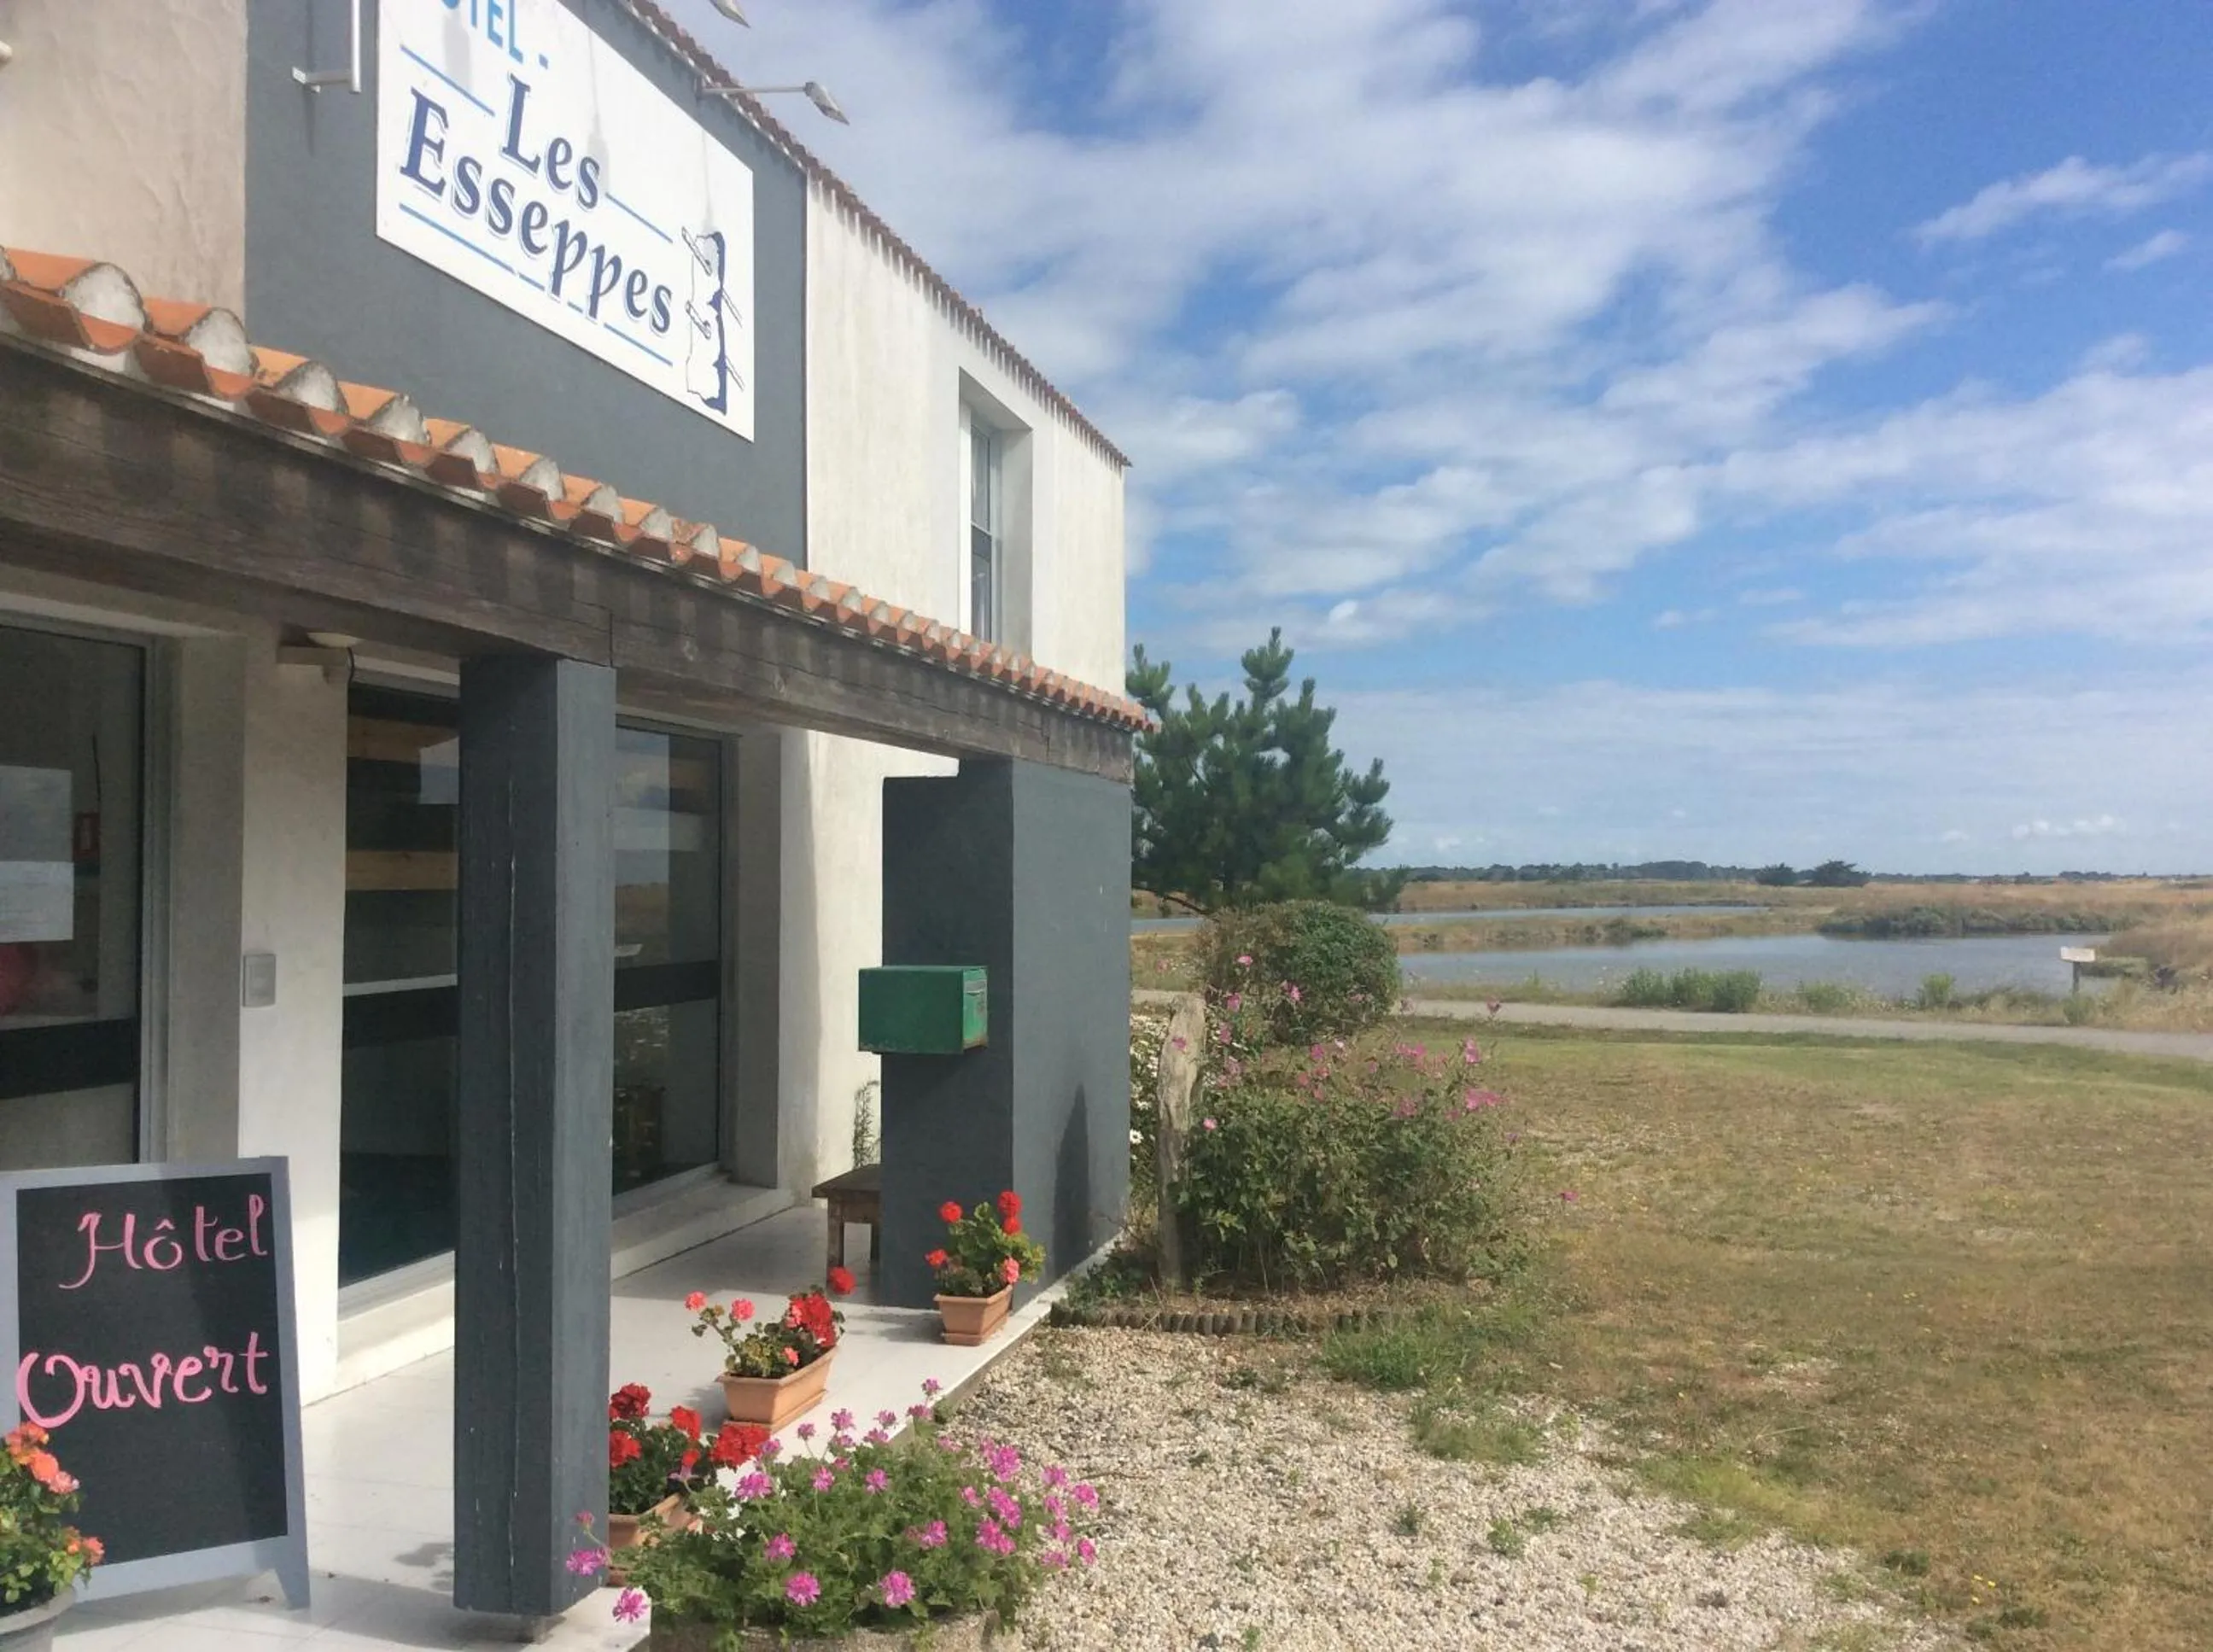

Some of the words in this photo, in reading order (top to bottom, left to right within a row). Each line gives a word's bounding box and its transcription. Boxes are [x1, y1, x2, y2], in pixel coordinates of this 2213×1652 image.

[500, 73, 601, 210] Les
[400, 87, 673, 334] Esseppes
[58, 1194, 267, 1289] Hôtel
[16, 1332, 268, 1428] Ouvert
